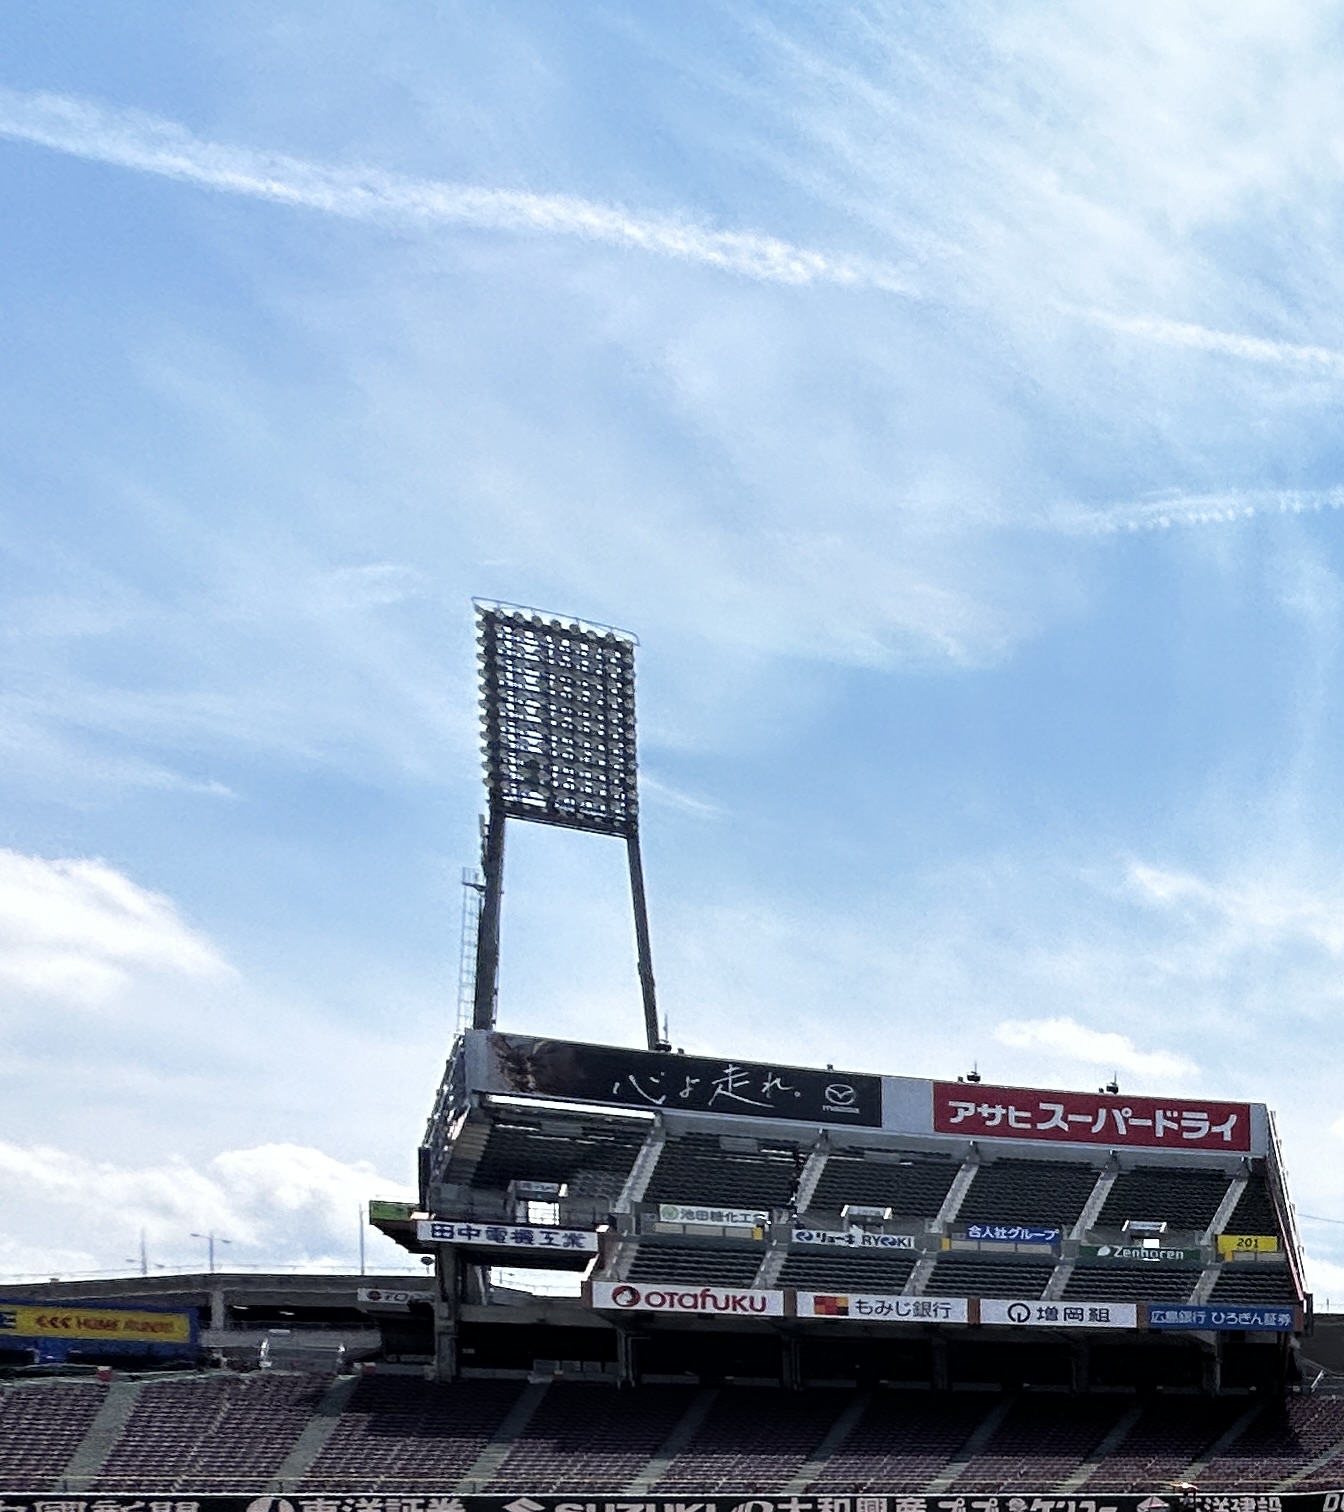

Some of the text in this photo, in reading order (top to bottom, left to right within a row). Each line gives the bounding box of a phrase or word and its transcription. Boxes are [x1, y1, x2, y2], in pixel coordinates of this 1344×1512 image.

[948, 1100, 1238, 1142] アサヒスーパードライ
[1236, 1238, 1259, 1249] 201
[855, 1299, 951, 1320] もみじ銀行
